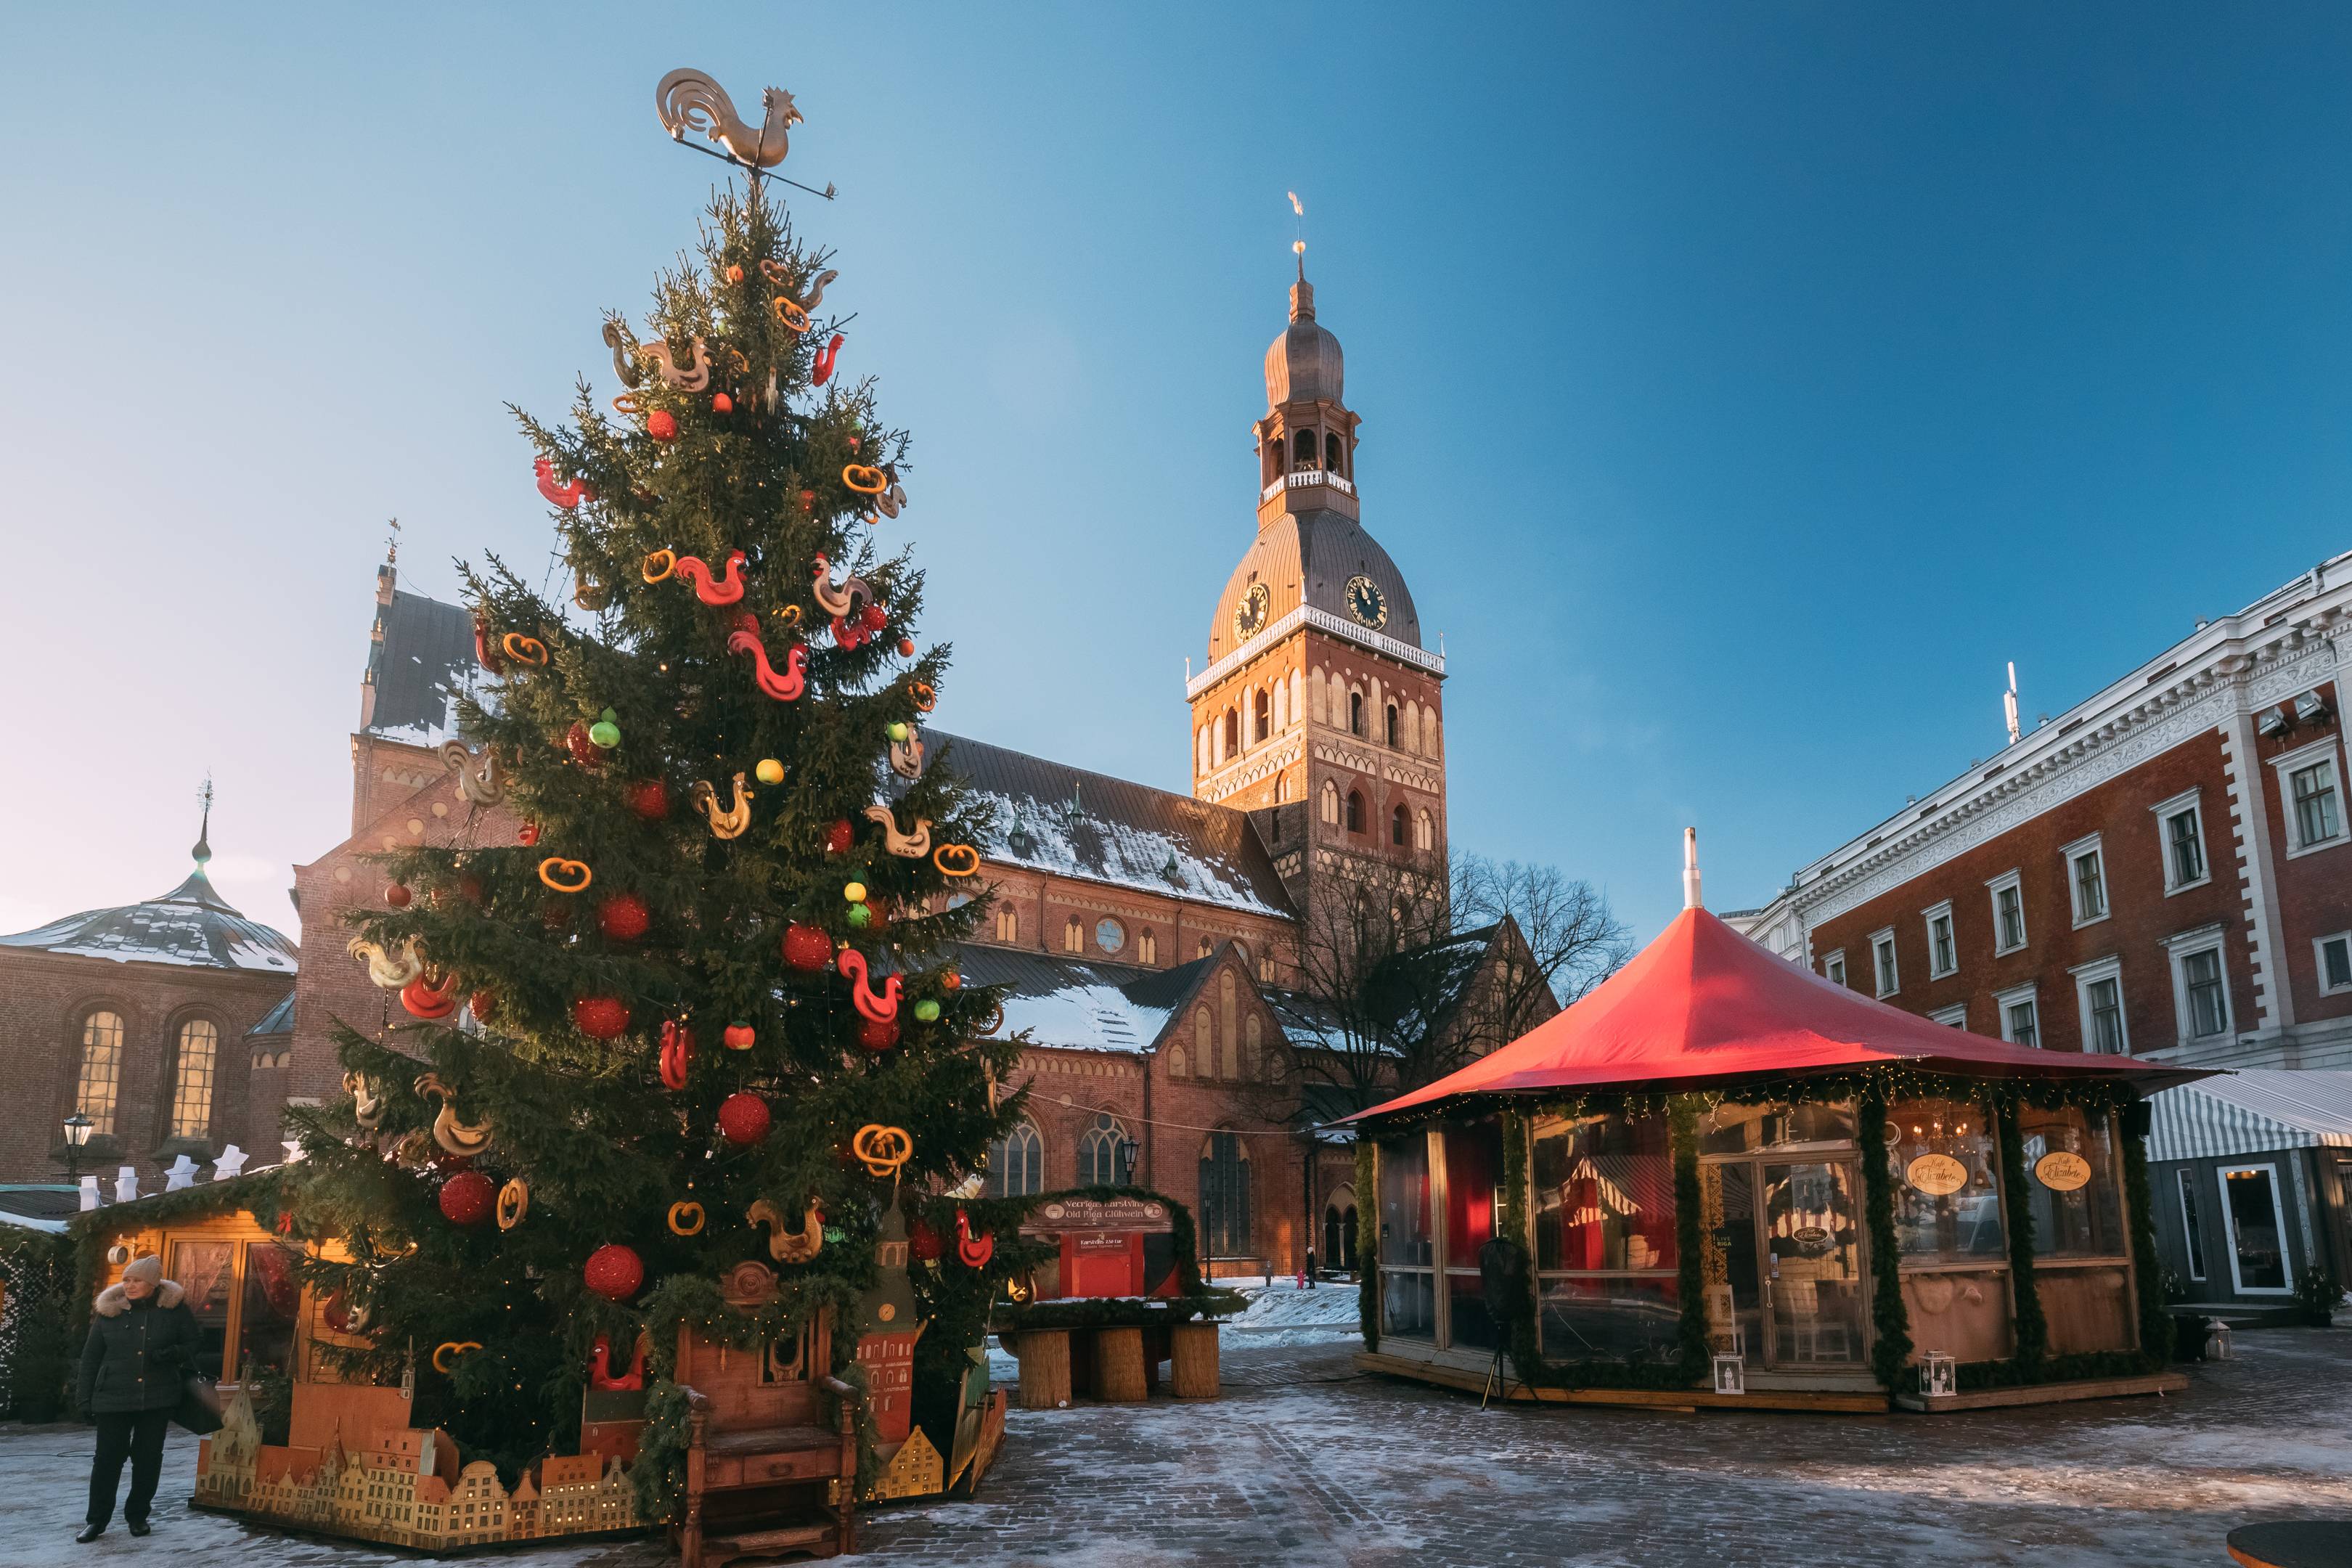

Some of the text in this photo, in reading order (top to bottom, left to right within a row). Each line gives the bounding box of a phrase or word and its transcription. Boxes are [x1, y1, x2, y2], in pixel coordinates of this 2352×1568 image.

[1915, 1165, 1958, 1184] Elizabete
[2043, 1163, 2082, 1180] Elizabete
[1083, 1210, 1102, 1222] Riga
